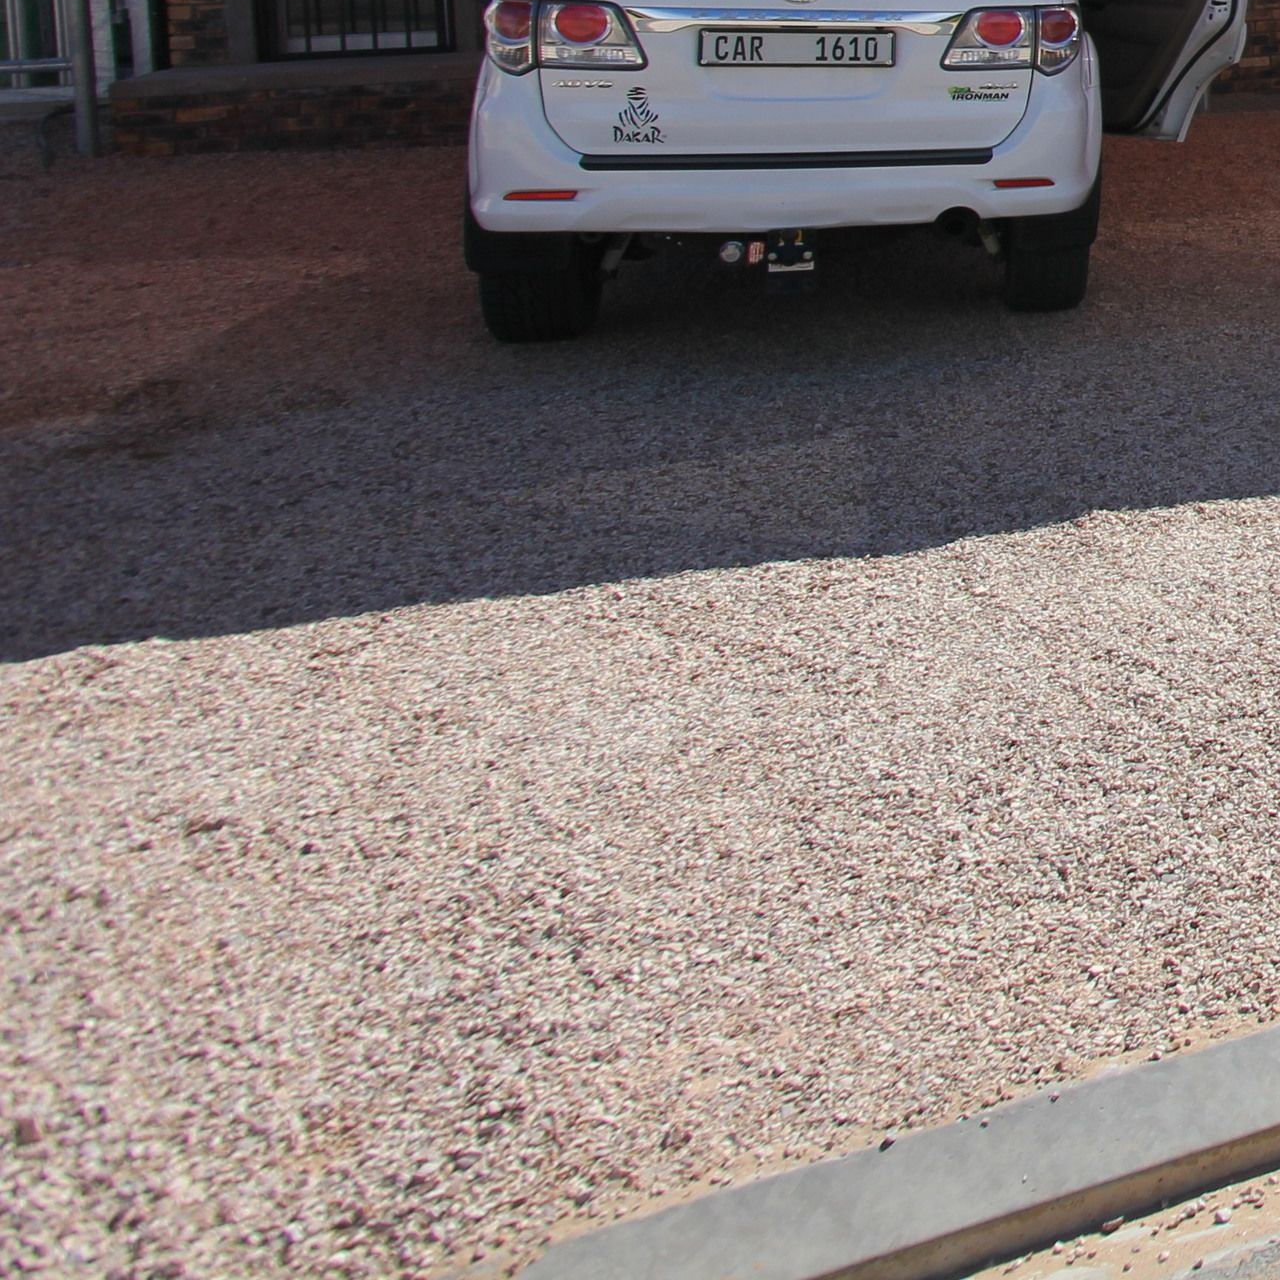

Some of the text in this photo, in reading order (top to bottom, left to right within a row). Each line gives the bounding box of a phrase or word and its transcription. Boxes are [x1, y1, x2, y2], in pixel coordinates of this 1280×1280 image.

[714, 35, 878, 62] CAR 1610
[951, 92, 1010, 101] IRONMAN
[613, 125, 665, 144] DAKAR
